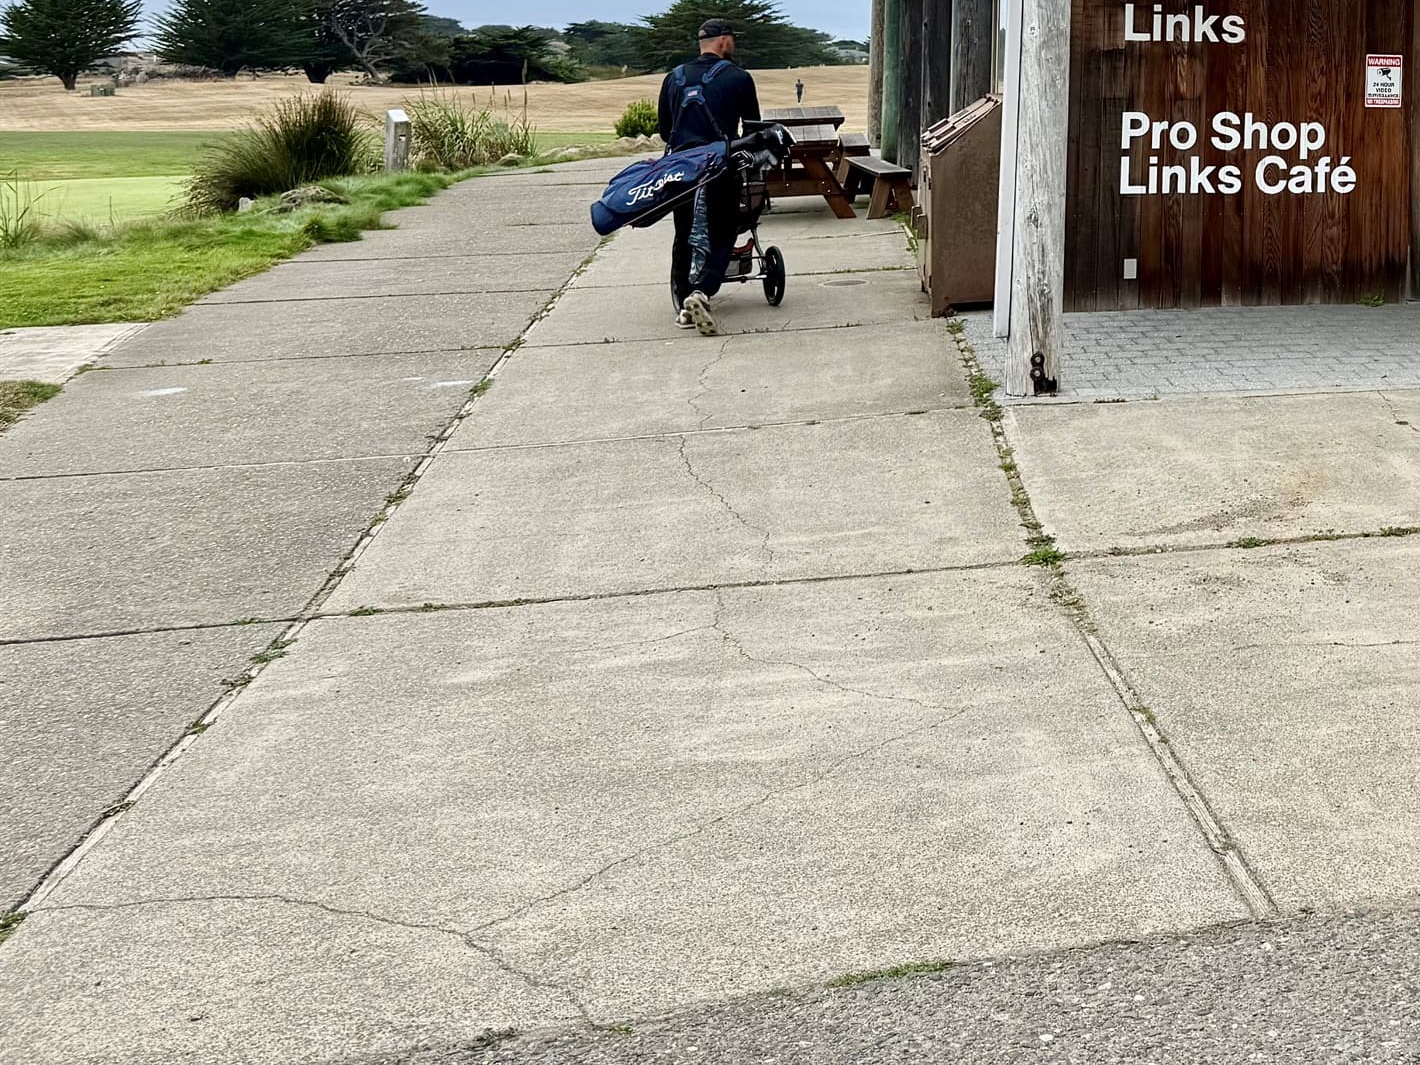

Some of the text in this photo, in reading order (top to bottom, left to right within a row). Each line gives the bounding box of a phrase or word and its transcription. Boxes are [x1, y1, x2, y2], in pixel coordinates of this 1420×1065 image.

[1124, 3, 1246, 44] Links
[1368, 58, 1400, 66] WARNING
[1121, 111, 1326, 159] Pro Shop
[1119, 155, 1357, 195] Links Café
